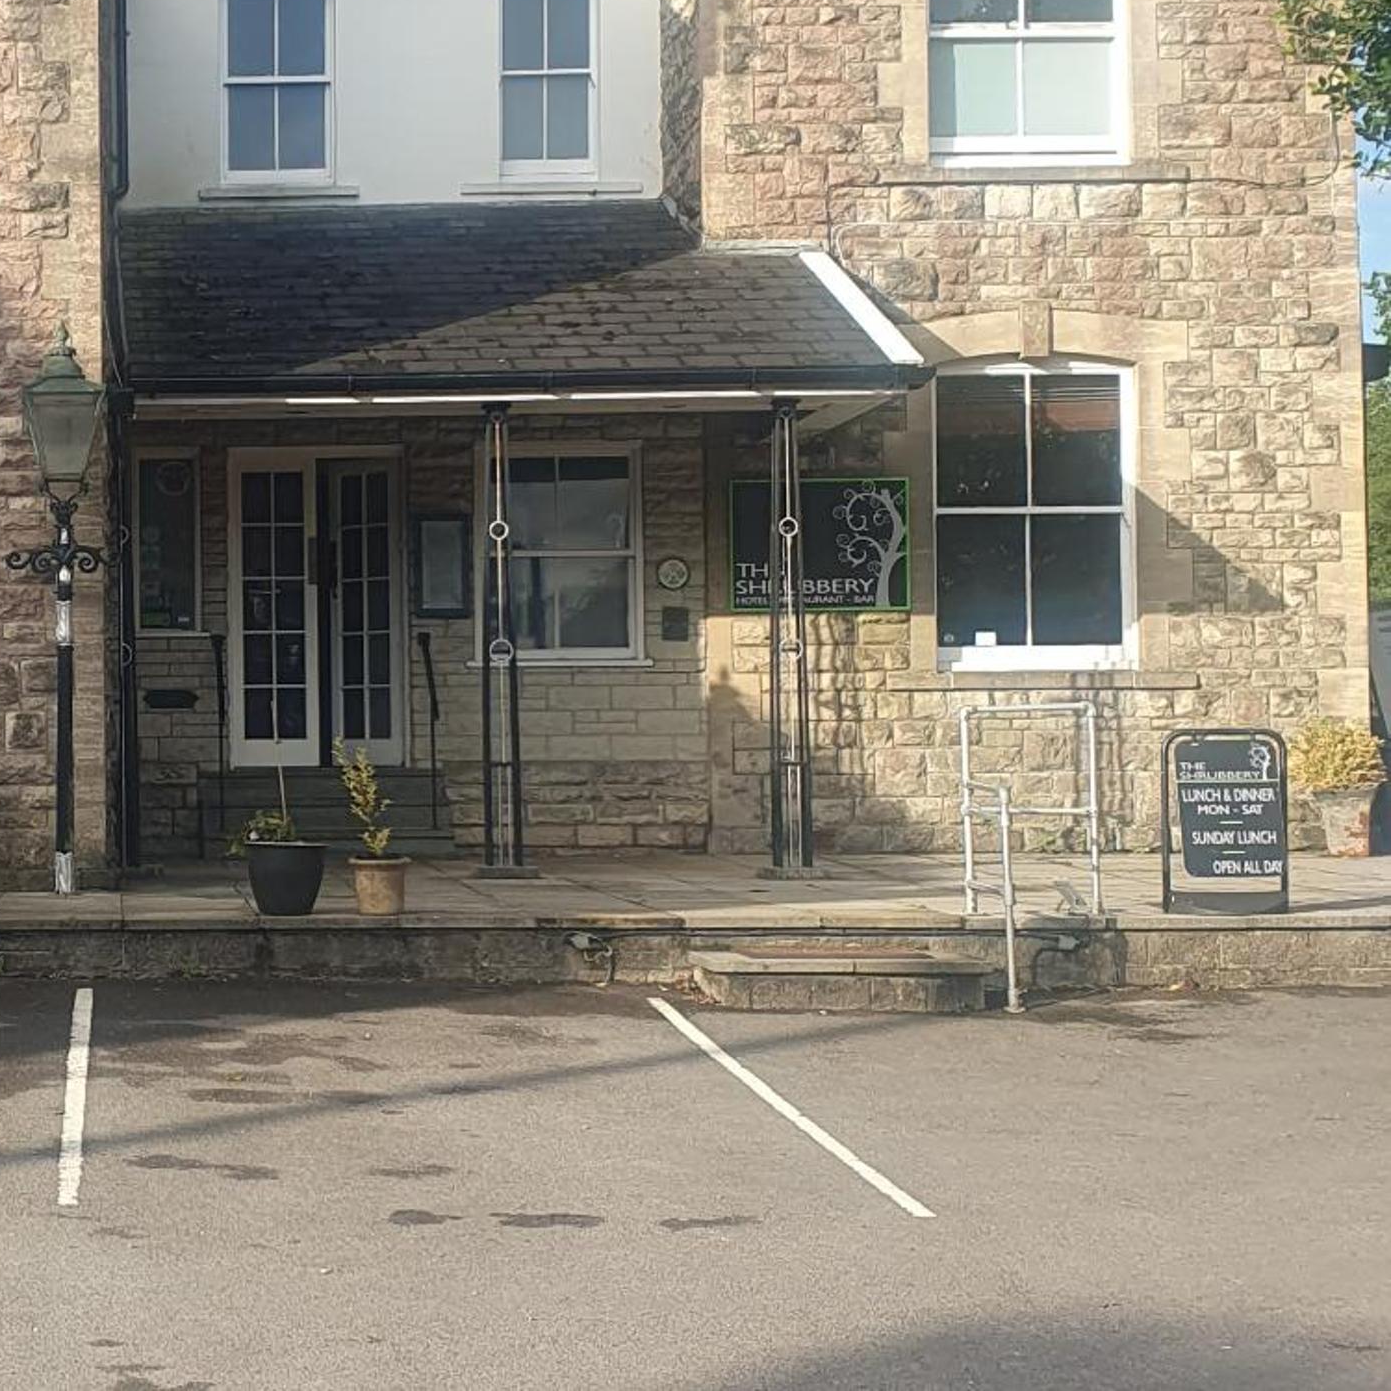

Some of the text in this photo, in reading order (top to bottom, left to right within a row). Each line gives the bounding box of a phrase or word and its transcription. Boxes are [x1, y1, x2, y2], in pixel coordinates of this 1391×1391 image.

[736, 563, 777, 578] TH
[736, 579, 874, 595] SHBBERY
[1179, 762, 1206, 771] THE
[1181, 788, 1275, 802] LUNCH & DINNER
[1197, 804, 1230, 815] MON
[1242, 804, 1263, 815] SAT
[1191, 831, 1277, 845] SUNDAY LUNCH
[1212, 859, 1283, 874] OPEN ALL DAY
